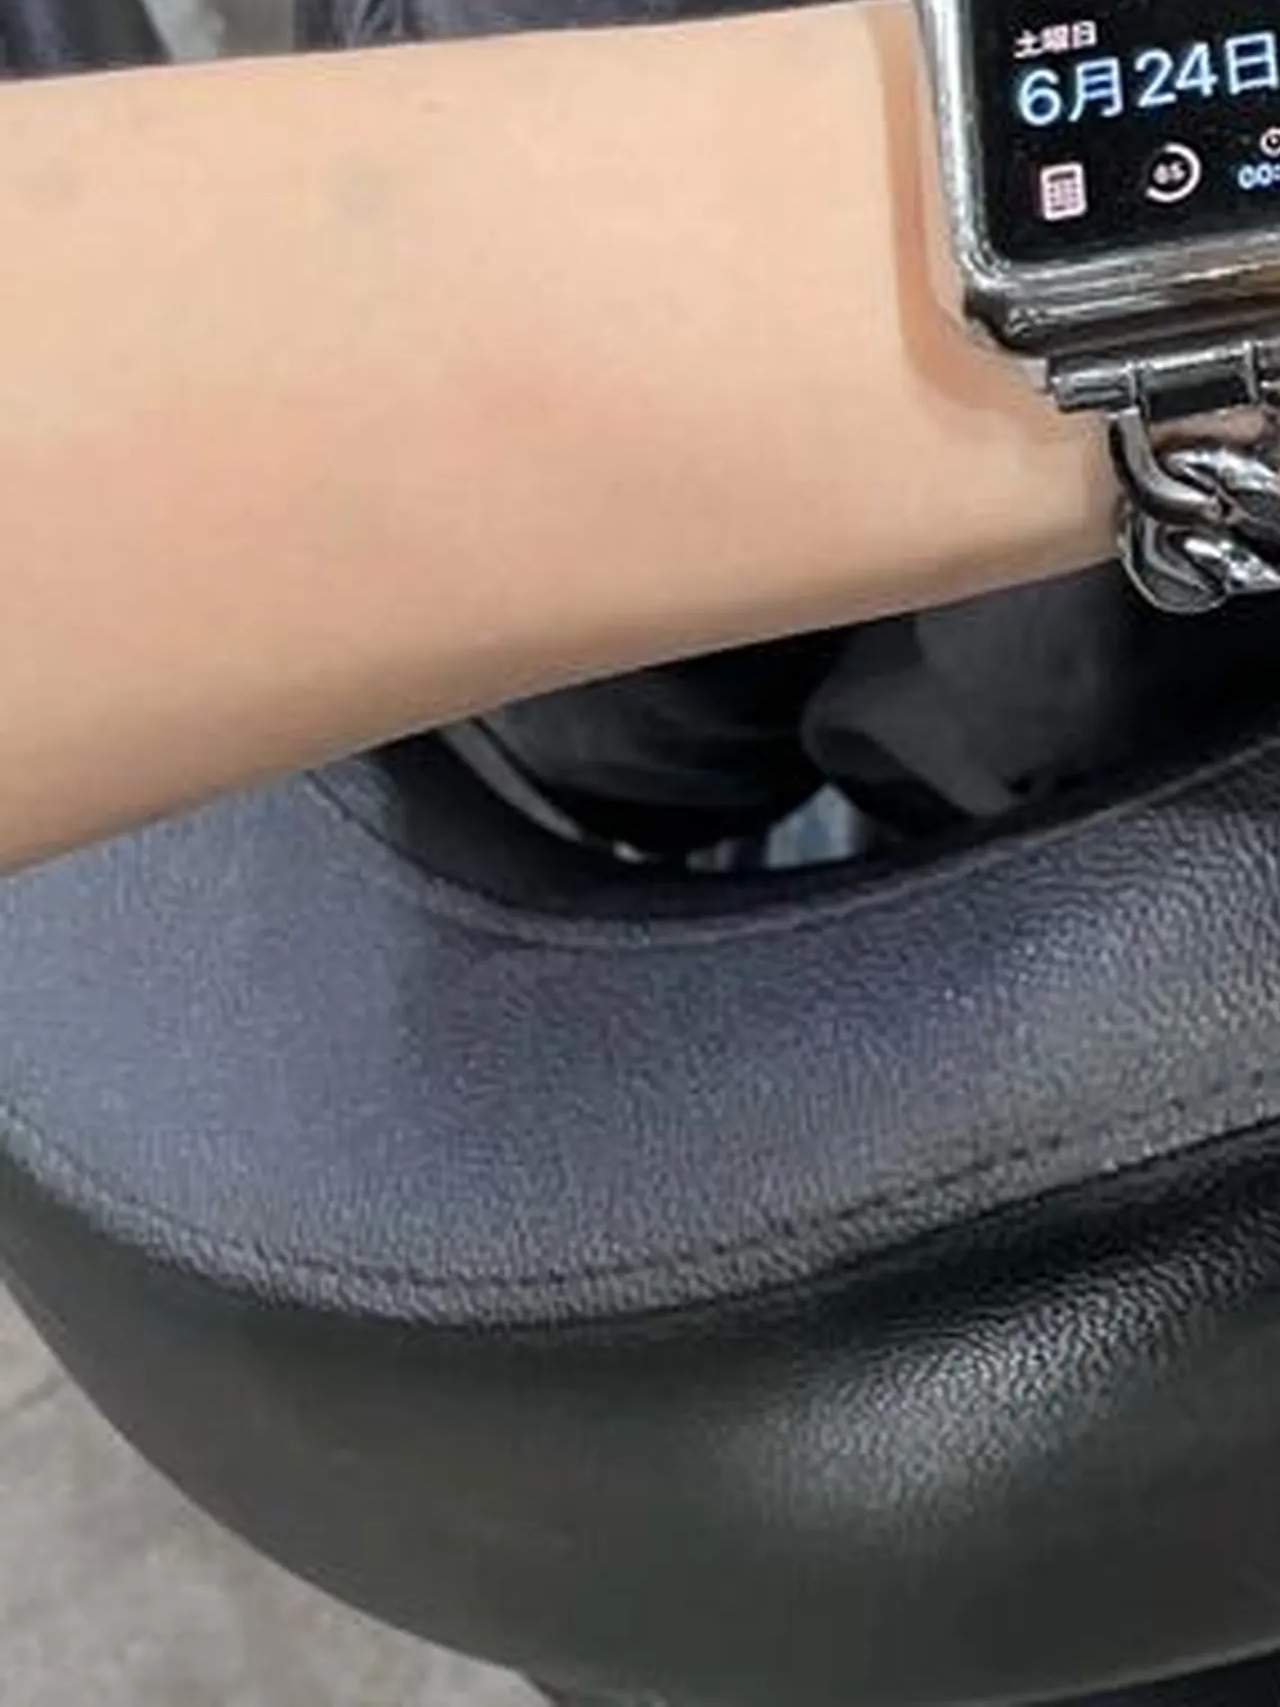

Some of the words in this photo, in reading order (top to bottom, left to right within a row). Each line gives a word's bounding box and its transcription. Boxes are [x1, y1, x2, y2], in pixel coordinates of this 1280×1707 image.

[1014, 20, 1097, 58] 土曜日
[1018, 31, 1278, 125] 6月24日
